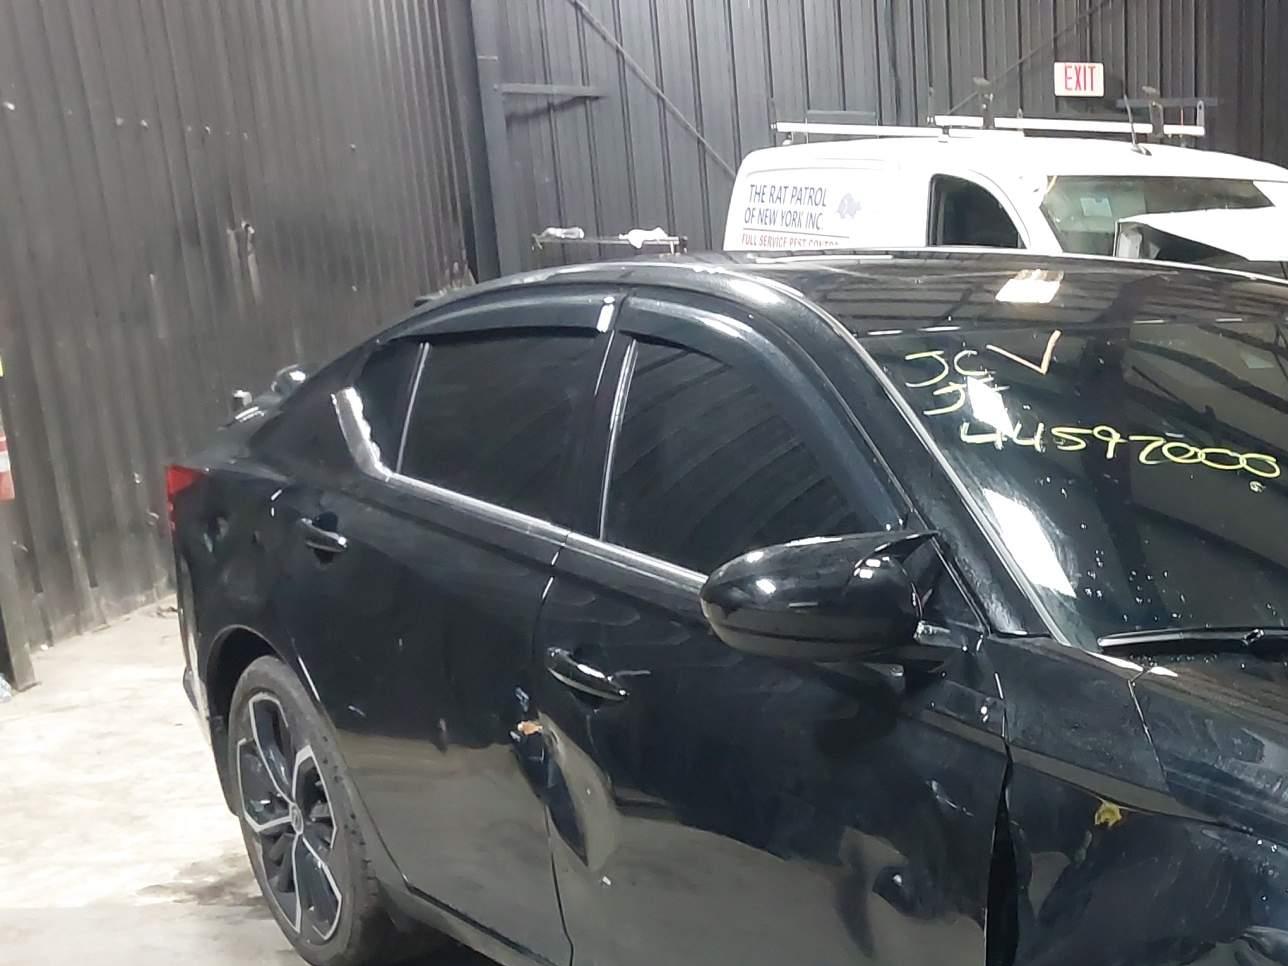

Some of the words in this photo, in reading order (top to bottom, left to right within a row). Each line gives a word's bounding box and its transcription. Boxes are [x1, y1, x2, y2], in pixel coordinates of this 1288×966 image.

[1064, 65, 1096, 92] EXIT
[749, 184, 768, 203] THE
[769, 185, 789, 205] RAT
[790, 186, 827, 208] PATROL
[744, 206, 756, 225] OF
[757, 207, 779, 227] NEW
[780, 208, 805, 229] YORK
[741, 232, 757, 247] FULL
[959, 422, 1282, 479] 44597000
